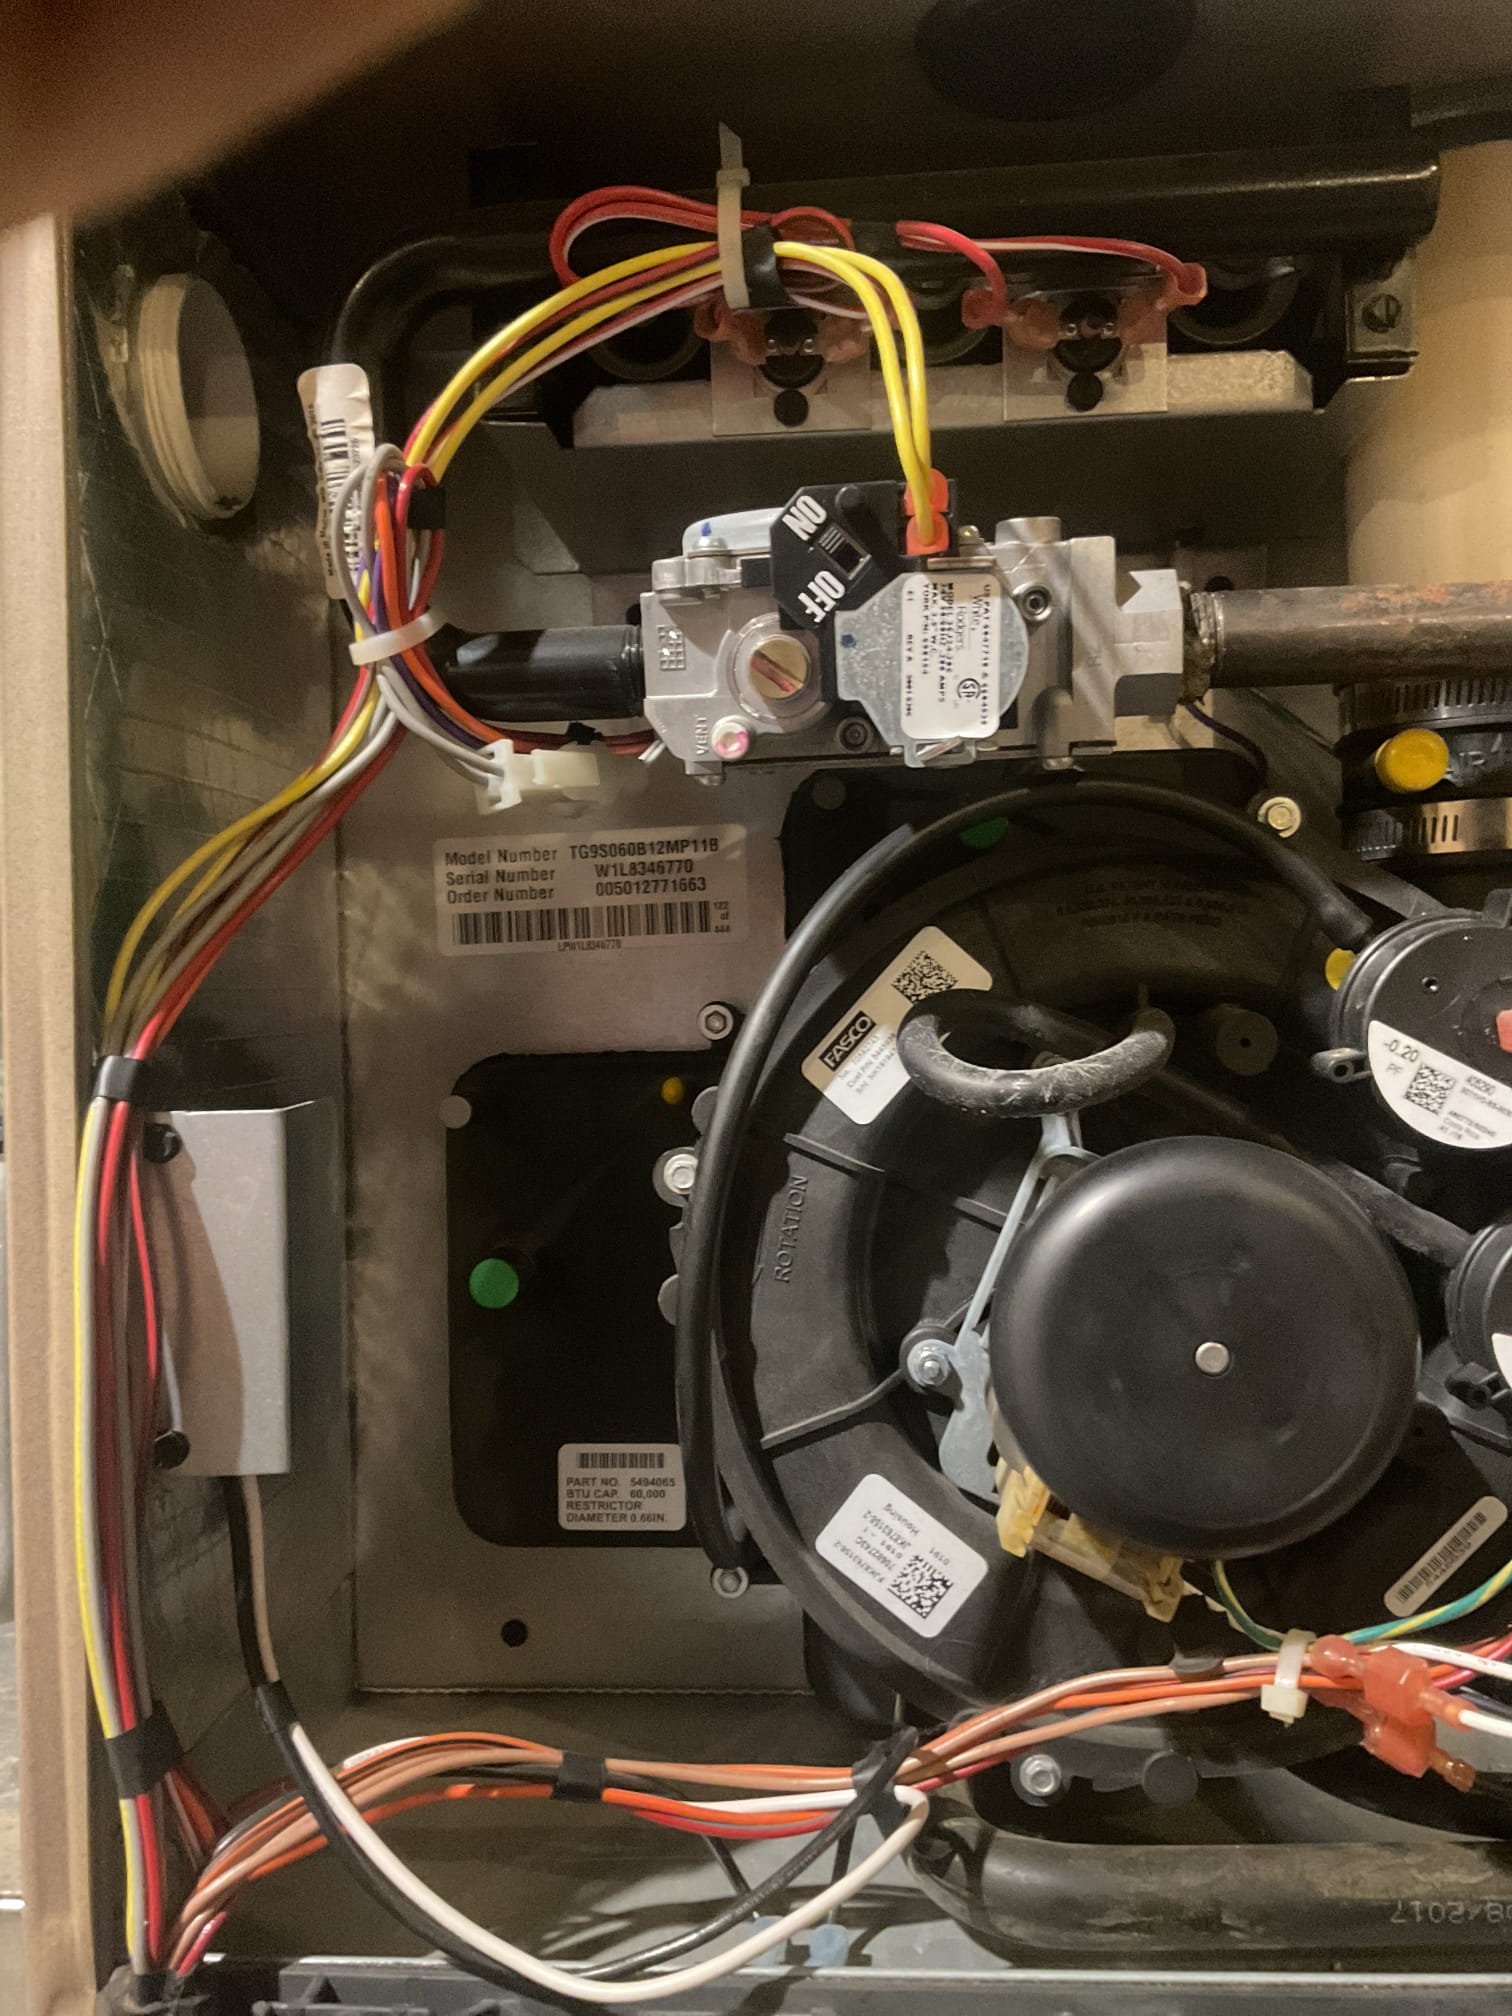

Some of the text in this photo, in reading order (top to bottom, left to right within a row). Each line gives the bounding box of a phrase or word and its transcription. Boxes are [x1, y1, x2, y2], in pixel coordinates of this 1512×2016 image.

[782, 495, 827, 540] ON
[798, 570, 846, 624] OFF
[955, 606, 967, 650] Rodgers
[445, 837, 720, 866] Model Number TG9S060B12MP11B
[446, 858, 694, 886] Serial Number W1L8346770
[447, 888, 491, 905] Order
[494, 886, 555, 902] Number
[823, 1015, 872, 1069] FASCO
[774, 1175, 808, 1283] ROTATION
[566, 1477, 597, 1487] PART
[566, 1489, 590, 1499] BTU
[630, 1489, 666, 1500] 60,000
[566, 1501, 642, 1511] RESTRICTOR
[566, 1513, 627, 1523] DIAMETER
[883, 1502, 920, 1537] Housing
